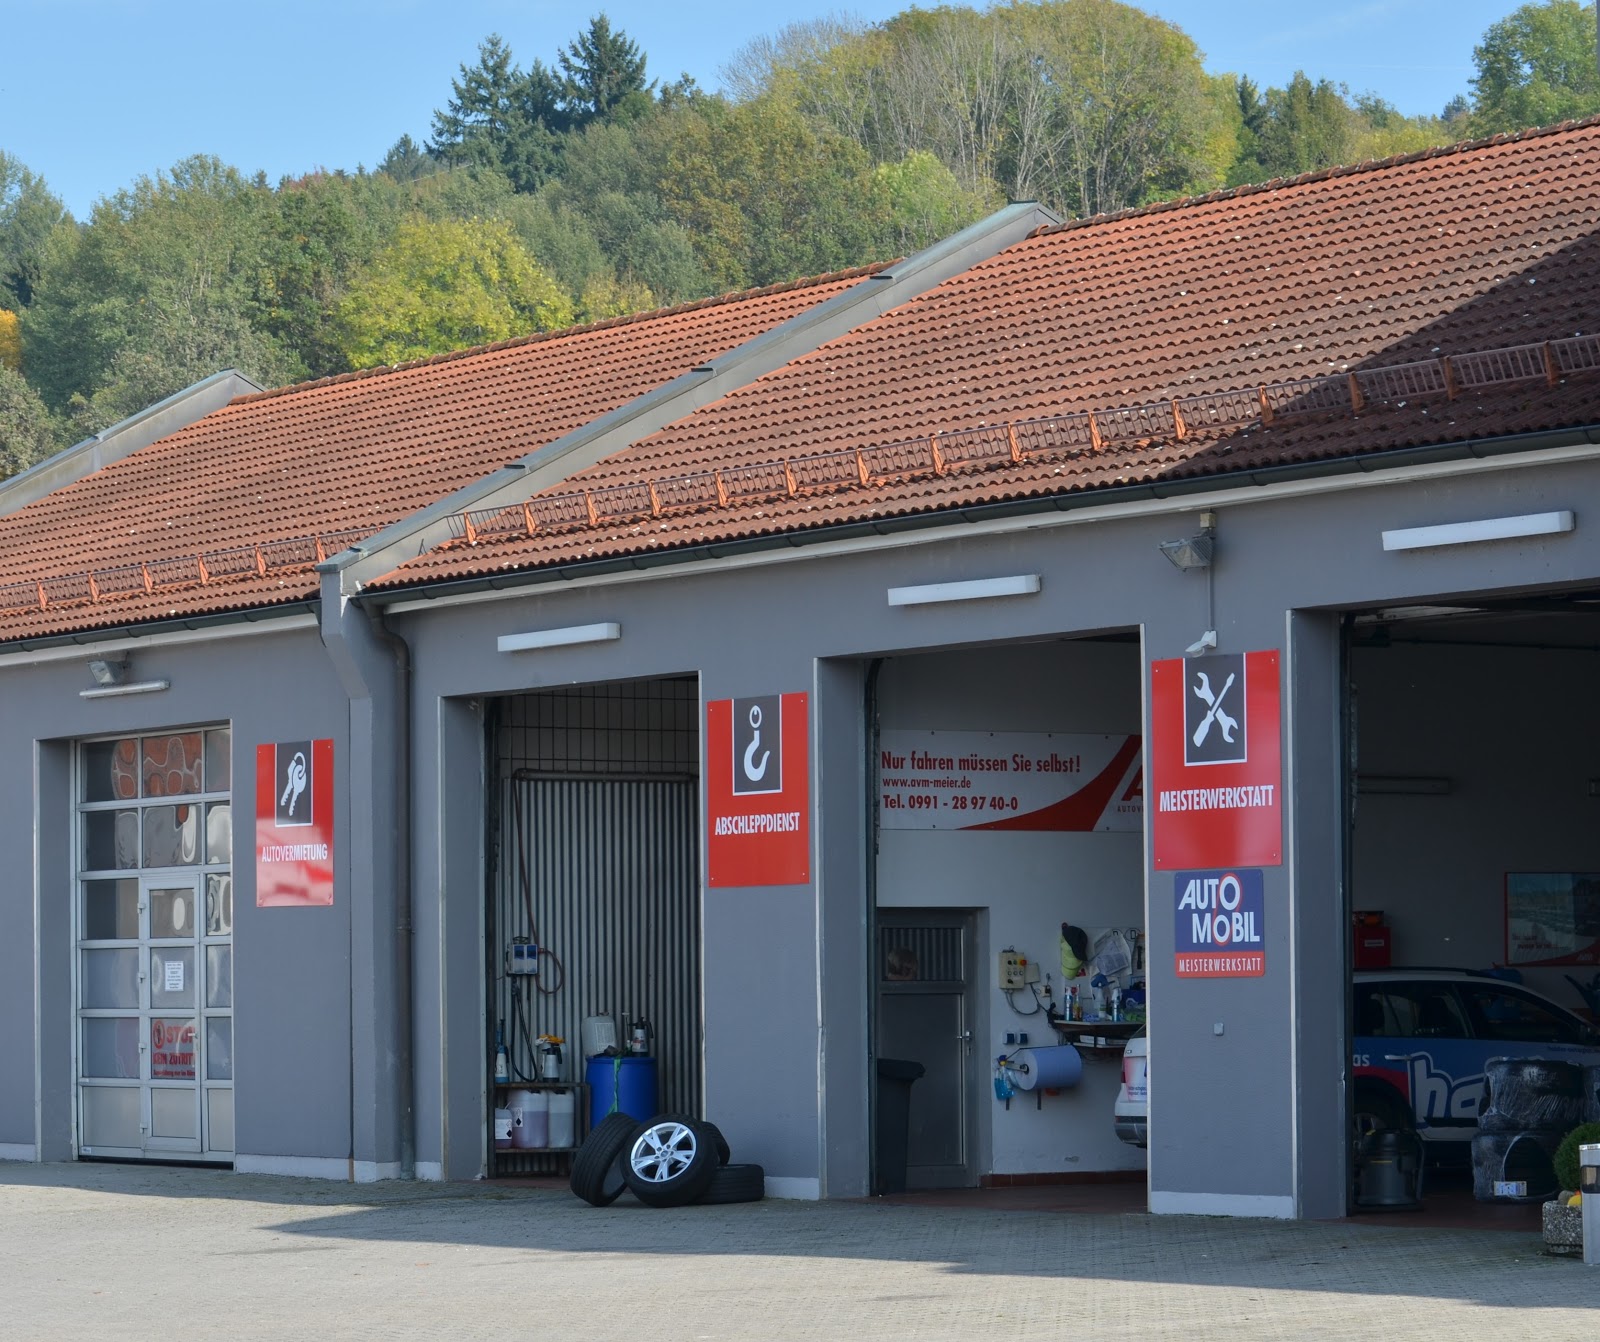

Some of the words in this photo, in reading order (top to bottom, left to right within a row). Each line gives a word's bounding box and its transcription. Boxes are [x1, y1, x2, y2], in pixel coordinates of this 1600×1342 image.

[881, 751, 906, 770] Nur
[911, 751, 954, 771] fahren
[958, 753, 1008, 772] müssen
[1012, 754, 1032, 773] Sie
[1036, 754, 1081, 773] selbst!
[882, 776, 971, 789] www.avm-meier.de
[882, 794, 905, 809] Tel.
[908, 795, 938, 810] 0991
[951, 796, 967, 810] 28
[971, 796, 986, 810] 97
[989, 797, 1018, 811] 40-0
[1159, 784, 1274, 812] MEISTERWERKSTATT
[1117, 805, 1143, 813] AUTOV
[714, 811, 801, 835] ABSCHLEPPDIENST
[261, 843, 328, 863] AUTOVERMIETUNG
[1178, 875, 1241, 911] AUTO
[1192, 911, 1260, 944] MOBIL
[1178, 958, 1261, 973] MEISTERWERKSTATT
[169, 1052, 195, 1065] ZUTRIT
